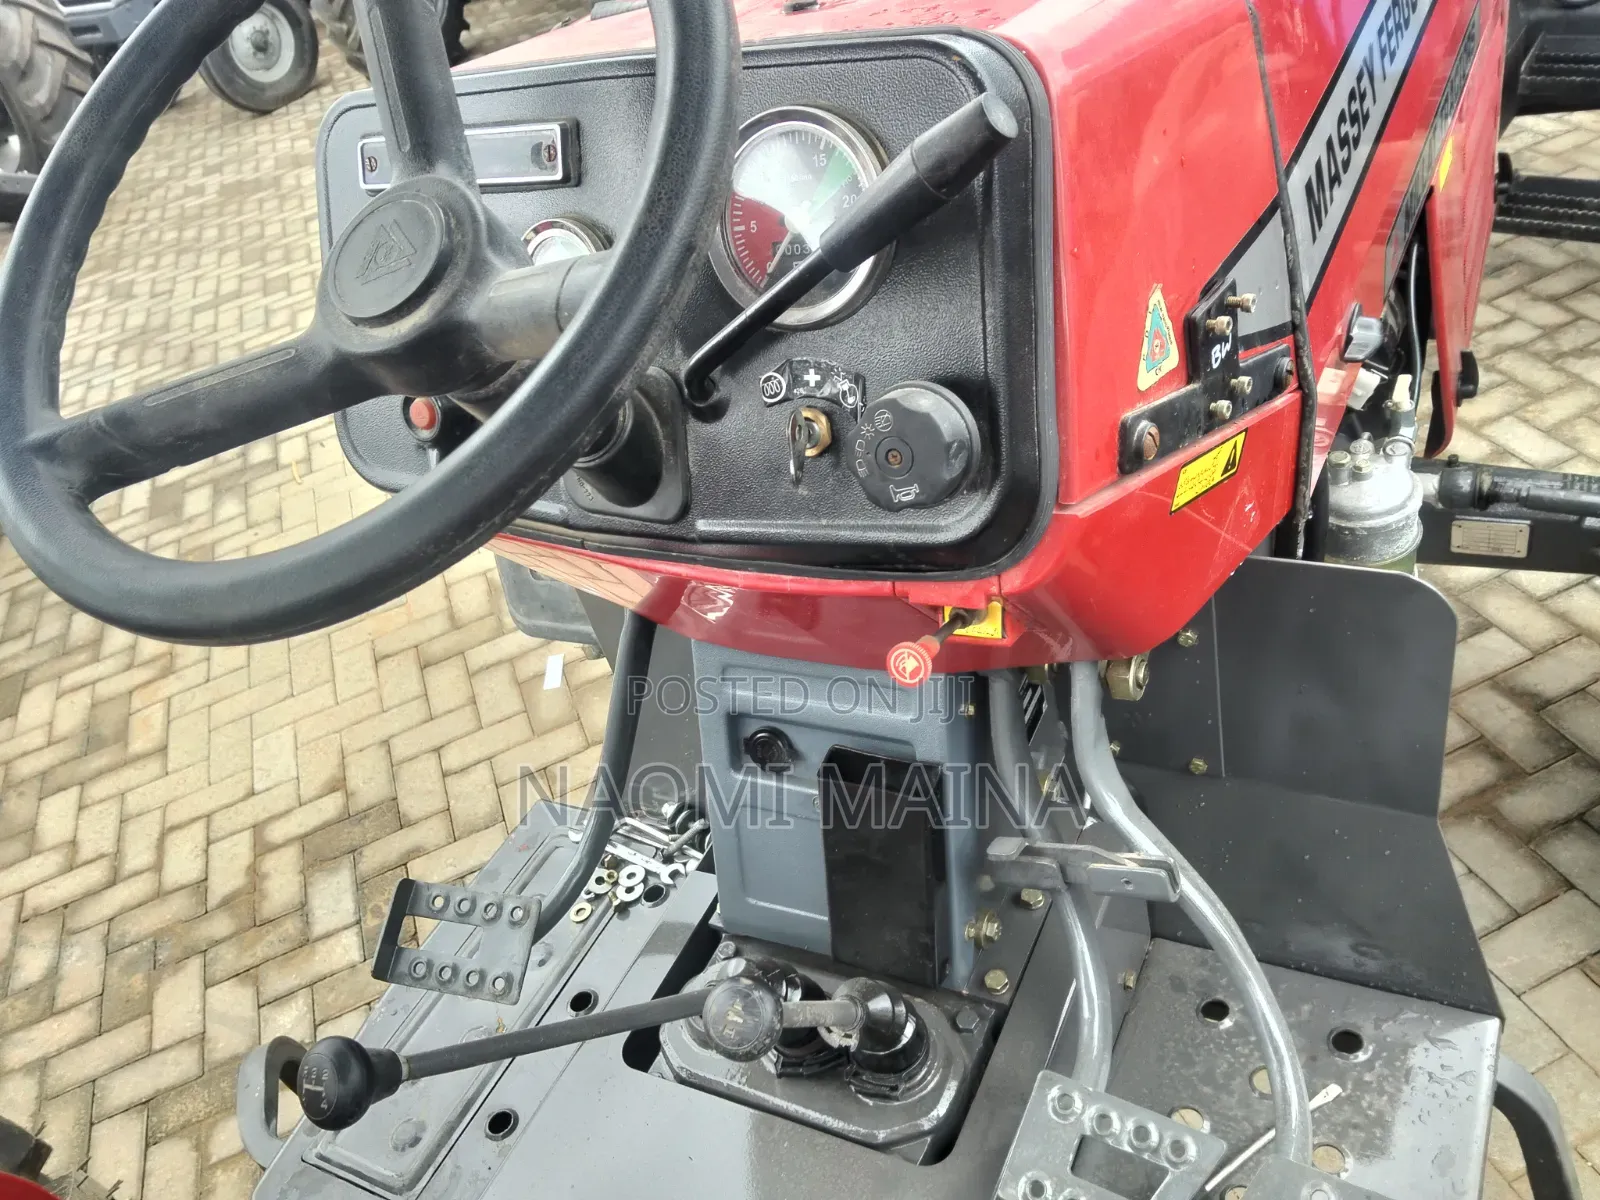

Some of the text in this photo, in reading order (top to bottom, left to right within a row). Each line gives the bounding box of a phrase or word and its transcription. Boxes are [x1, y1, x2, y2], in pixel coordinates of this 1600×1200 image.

[1305, 0, 1418, 245] MASSEY FERG
[812, 153, 827, 167] 15
[750, 221, 757, 232] 5
[1211, 333, 1232, 369] BW
